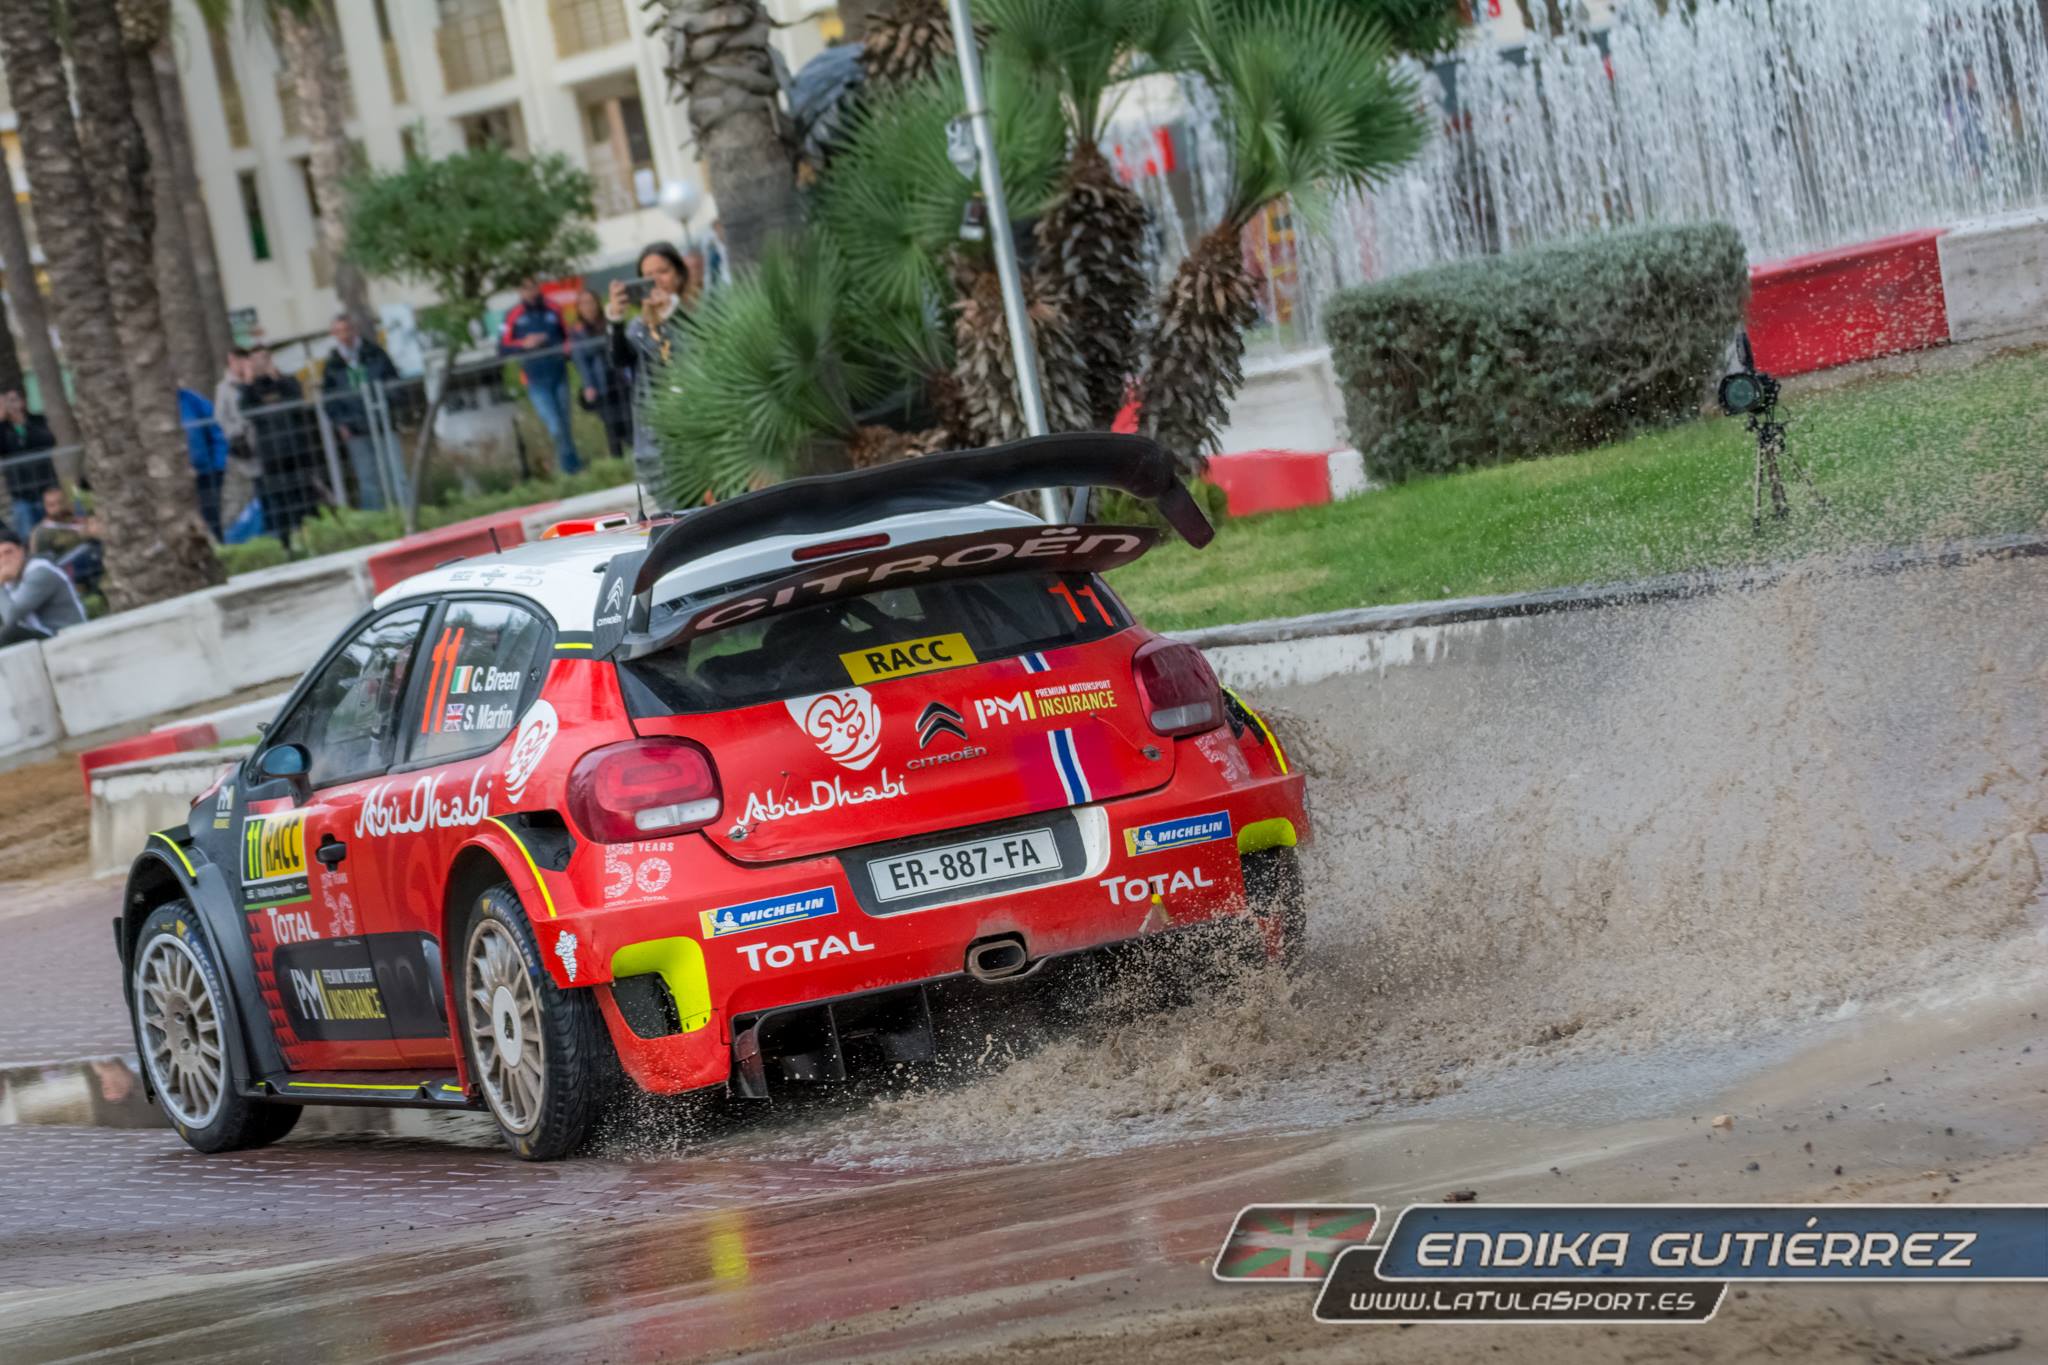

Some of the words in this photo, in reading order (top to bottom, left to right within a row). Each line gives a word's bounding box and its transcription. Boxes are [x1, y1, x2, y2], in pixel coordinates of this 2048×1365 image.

[695, 526, 1141, 631] CITROËN
[1047, 580, 1114, 628] 11
[864, 640, 953, 675] RACC
[421, 627, 465, 734] 11
[471, 666, 484, 693] C.
[484, 666, 521, 691] Breen
[1035, 684, 1067, 698] PREMIUM
[1069, 679, 1111, 693] MOTORSPORT
[463, 704, 475, 731] S.
[476, 703, 513, 730] Martin
[974, 690, 1038, 729] PMI
[1038, 690, 1118, 718] INSURANCE
[906, 745, 988, 771] CITROËN
[246, 820, 262, 880] 11
[264, 816, 301, 873] RACC
[639, 842, 675, 852] YEARS
[1158, 820, 1223, 843] MICHELIN
[603, 843, 672, 900] 50
[888, 838, 1041, 891] ER-887-FA
[1099, 866, 1214, 905] TOTAL
[266, 907, 320, 945] TOTAL
[740, 897, 825, 924] MICHELIN
[736, 930, 875, 972] TOTAL
